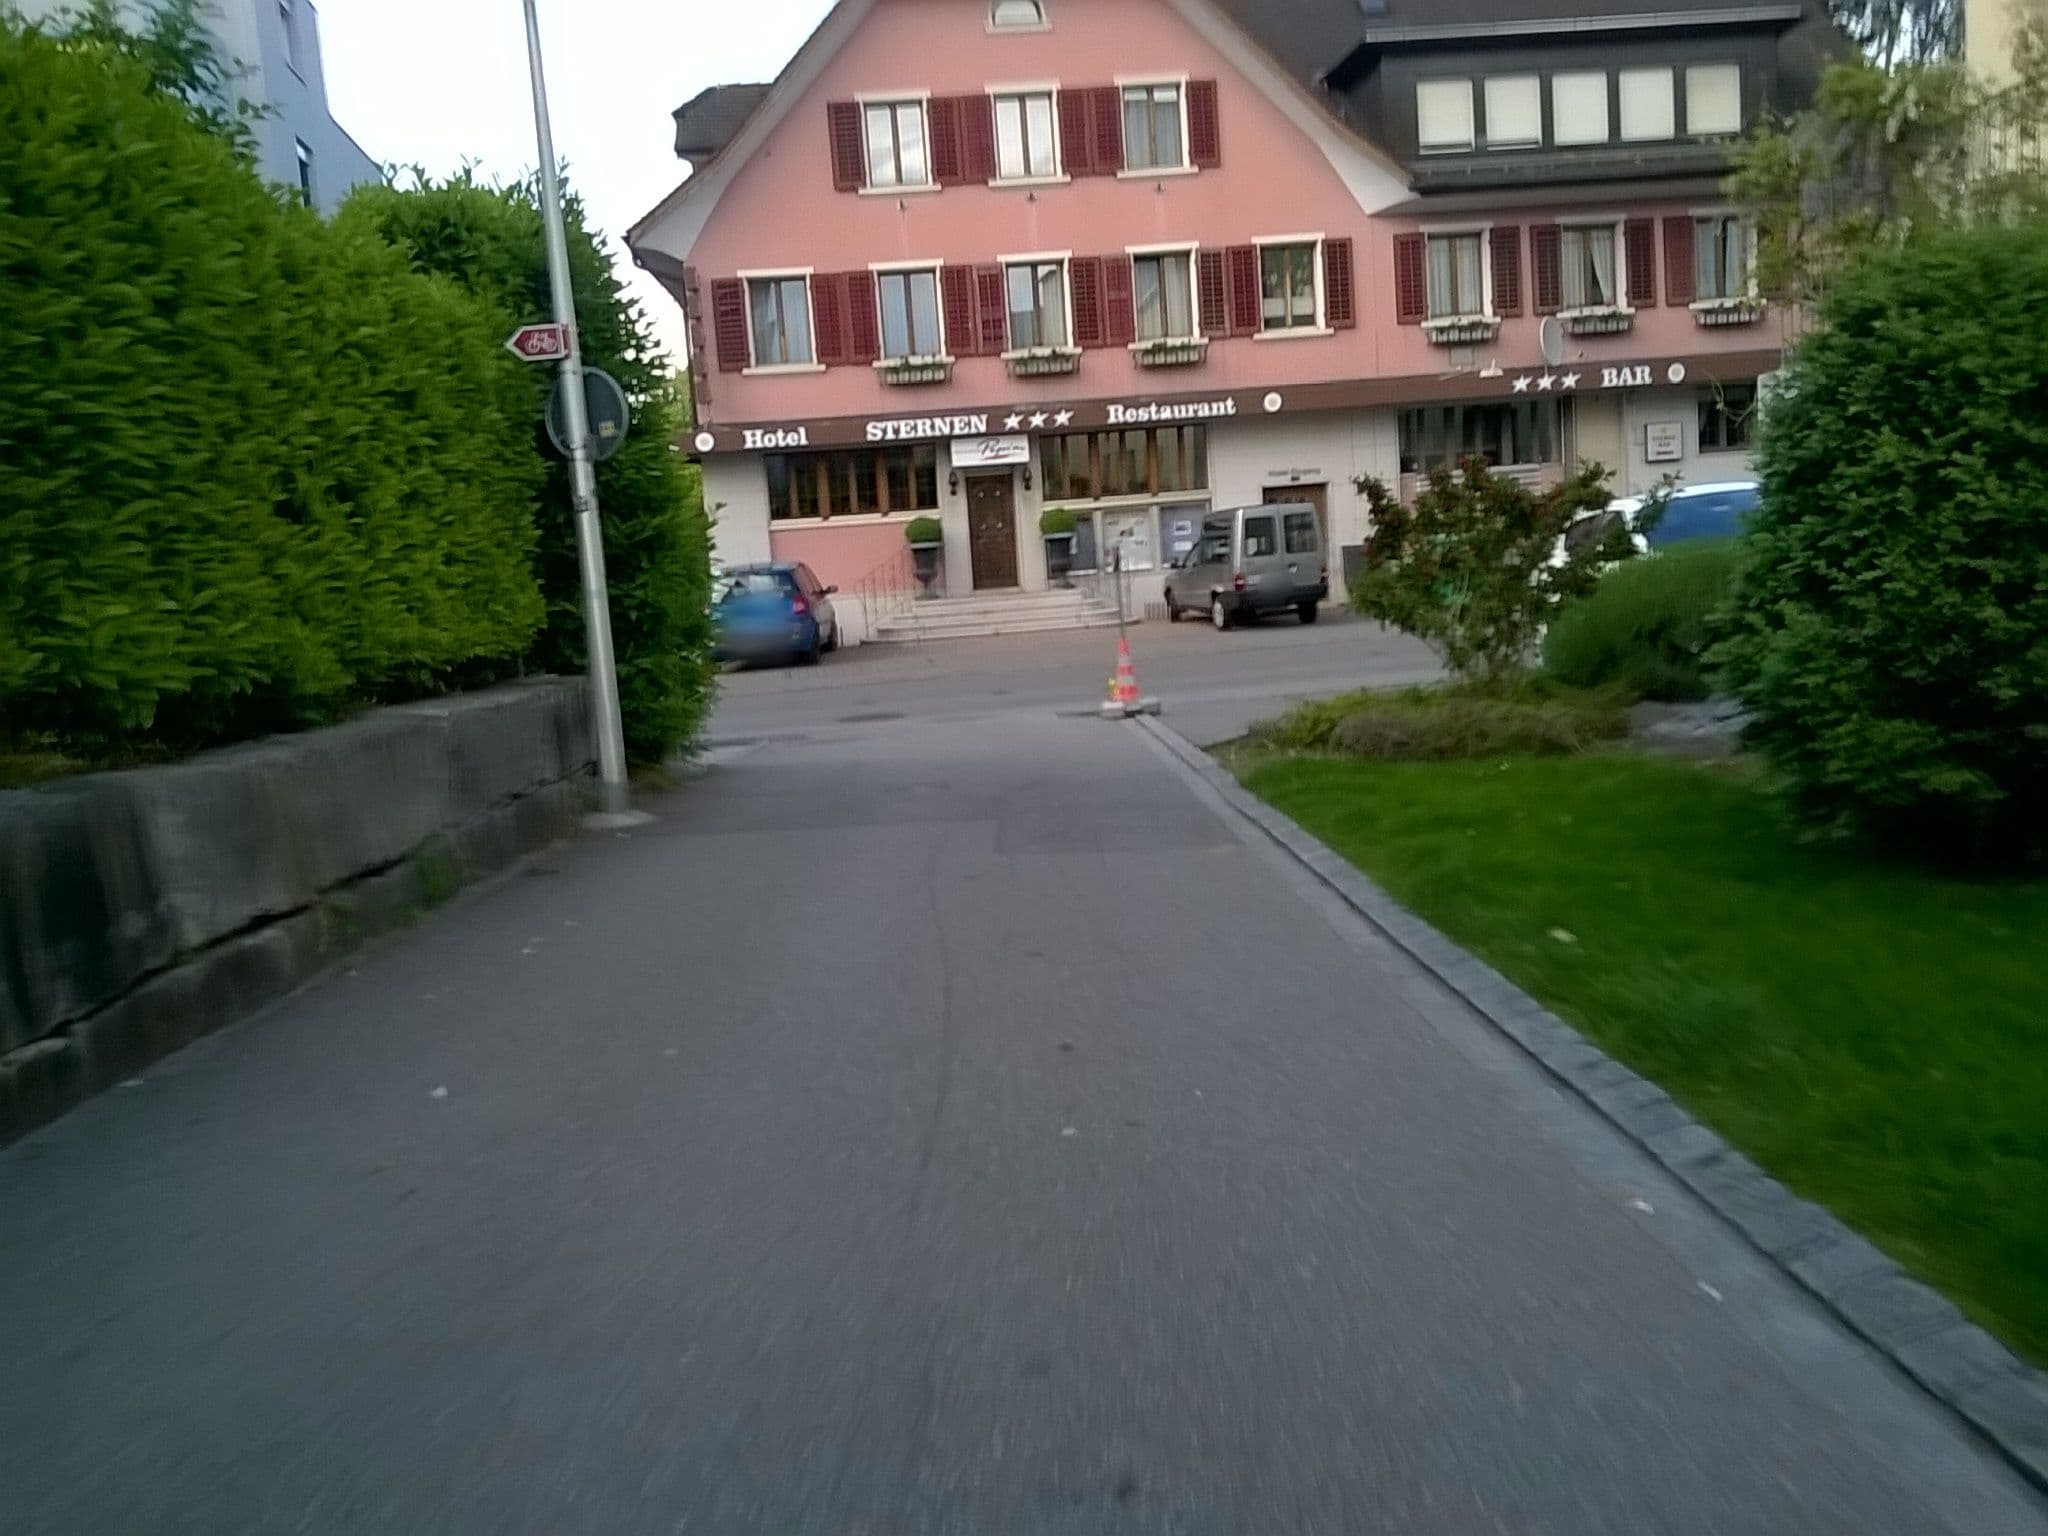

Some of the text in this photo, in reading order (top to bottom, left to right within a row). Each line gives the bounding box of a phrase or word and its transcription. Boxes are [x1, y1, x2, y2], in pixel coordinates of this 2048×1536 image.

[1600, 365, 1653, 387] BAR
[741, 397, 1236, 449] Hotel STERNEN Restaurant
